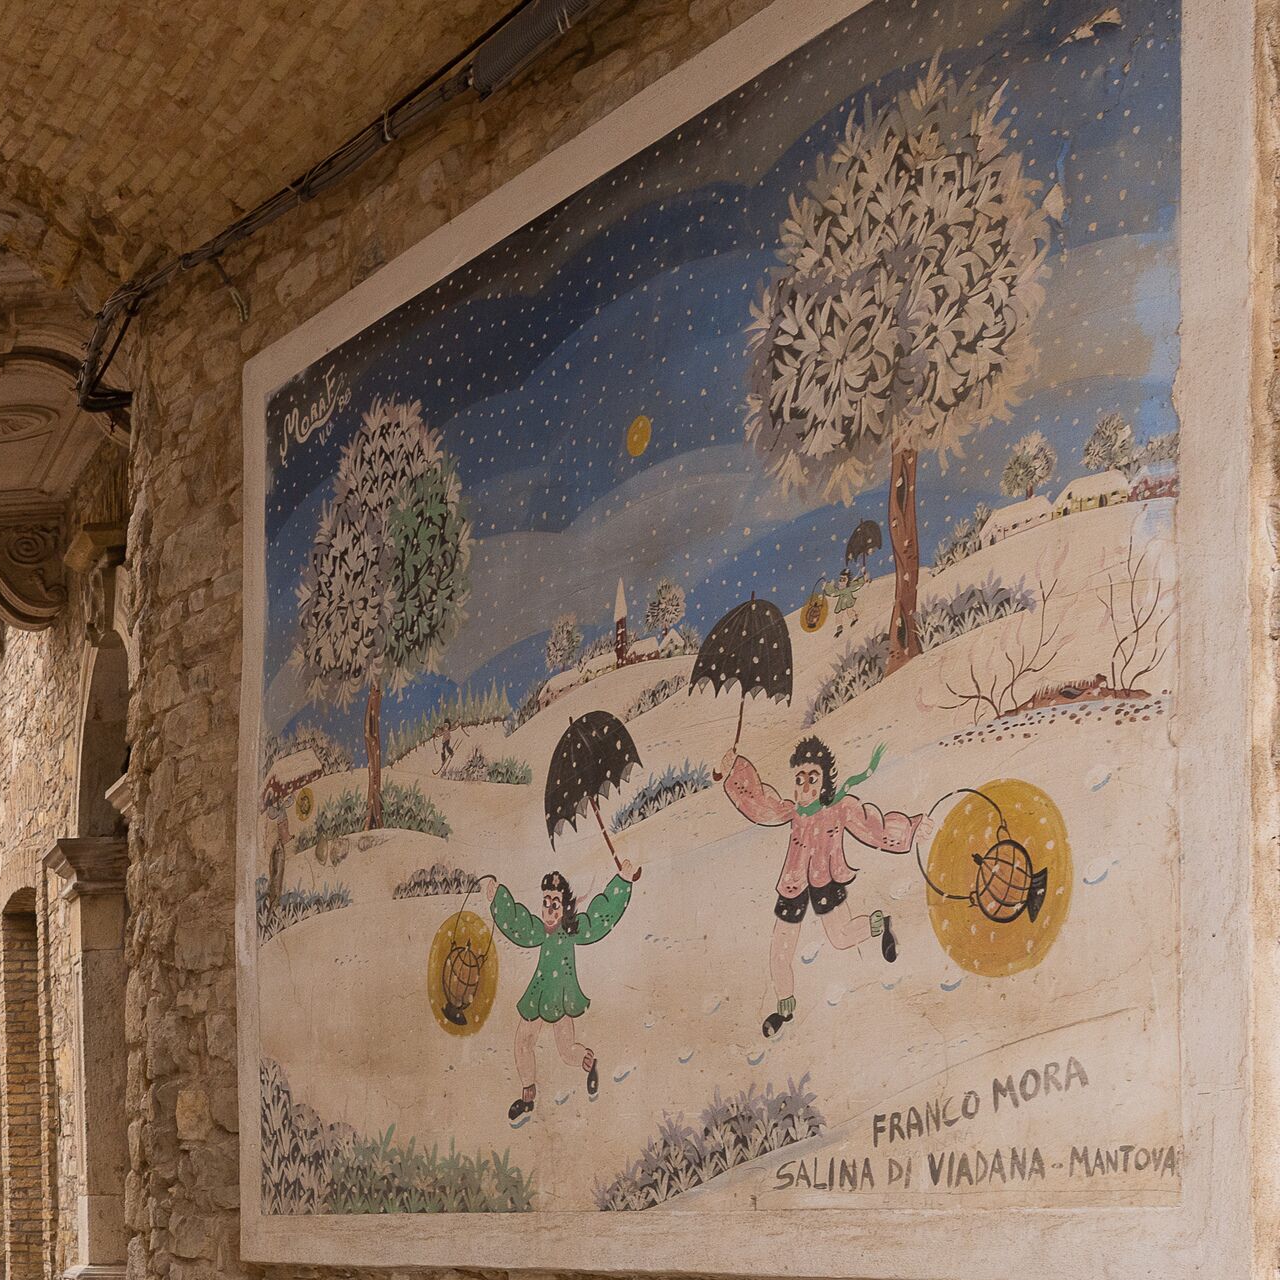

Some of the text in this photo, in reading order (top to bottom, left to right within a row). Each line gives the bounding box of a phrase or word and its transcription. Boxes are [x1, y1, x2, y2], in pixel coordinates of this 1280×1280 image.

[872, 1055, 1090, 1148] FRANCO MORA
[772, 1156, 875, 1192] SALINA
[887, 1157, 912, 1190] DI
[927, 1145, 1046, 1187] VIADANA
[1068, 1144, 1179, 1178] MANTOVA
